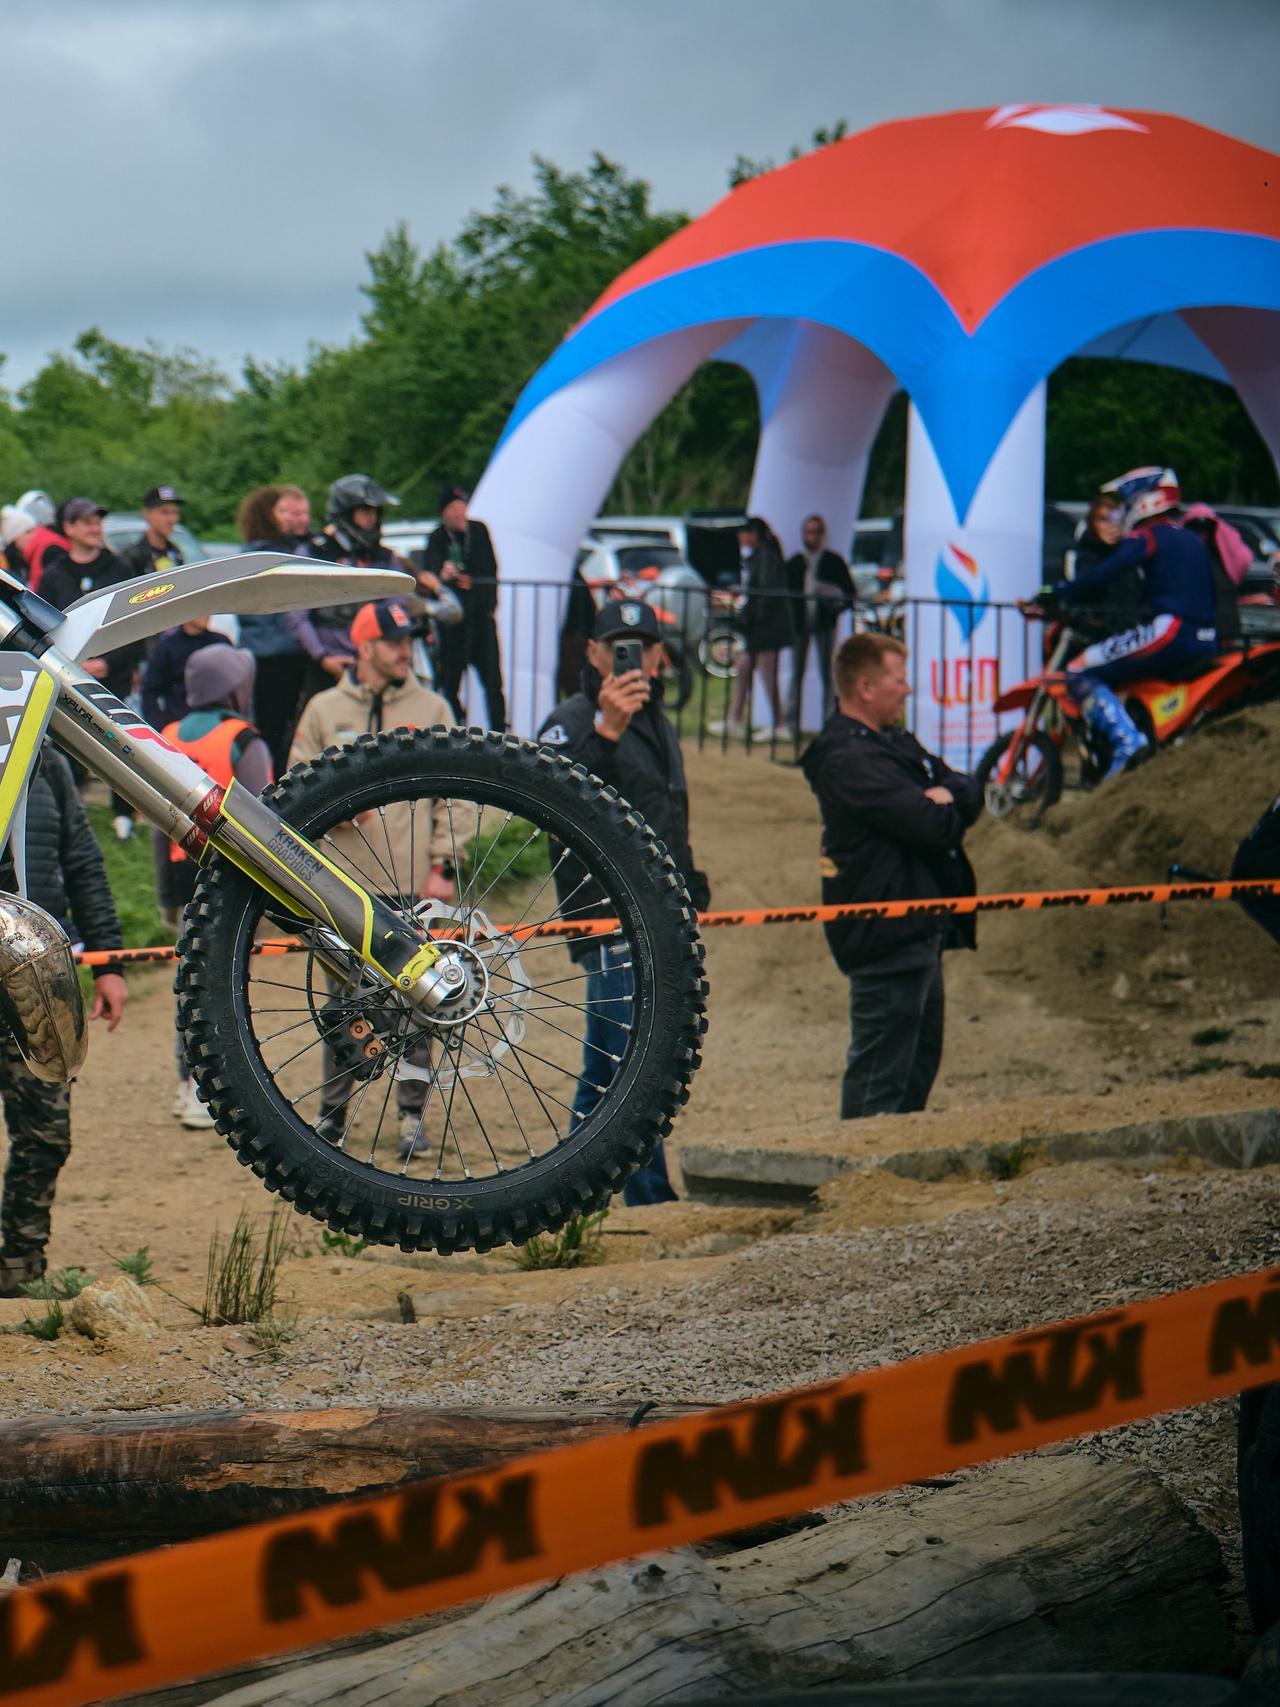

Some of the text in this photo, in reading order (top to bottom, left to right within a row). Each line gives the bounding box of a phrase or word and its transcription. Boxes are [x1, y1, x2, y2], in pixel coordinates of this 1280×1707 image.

[129, 584, 174, 604] FMF
[61, 693, 93, 722] XPLOR
[267, 837, 315, 881] GRAPHICS
[274, 829, 324, 874] KRAKEN
